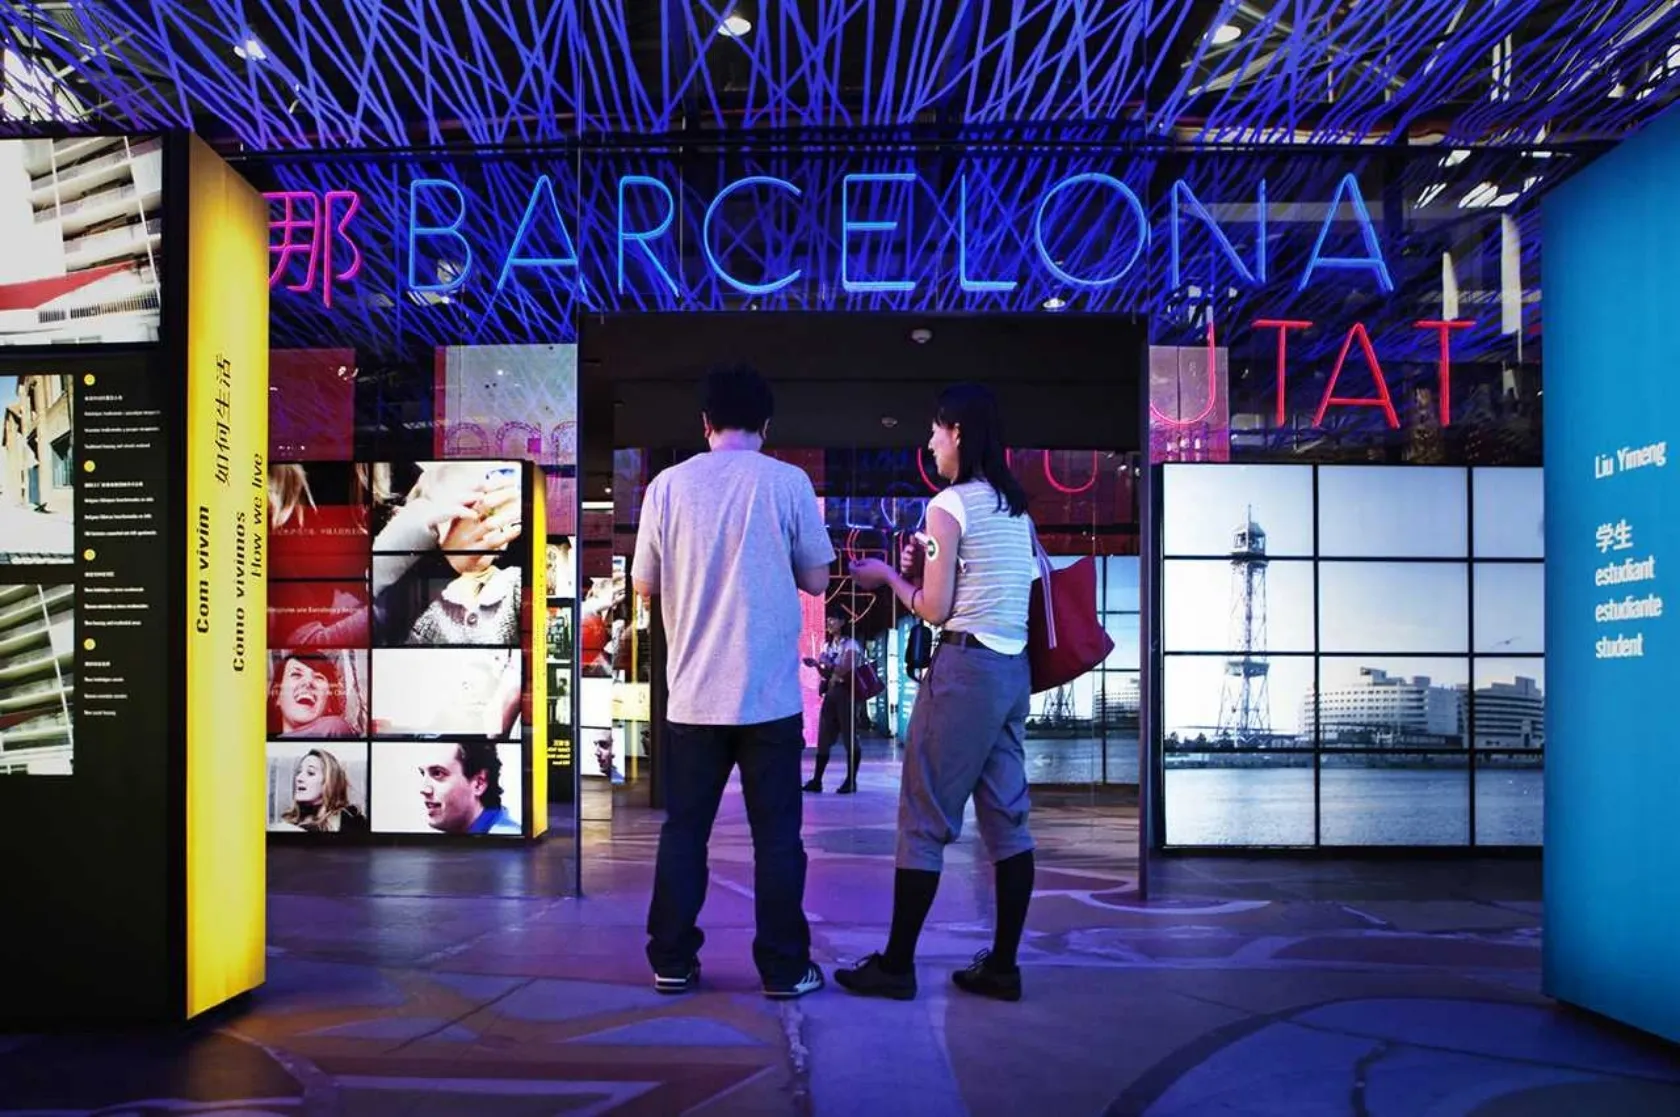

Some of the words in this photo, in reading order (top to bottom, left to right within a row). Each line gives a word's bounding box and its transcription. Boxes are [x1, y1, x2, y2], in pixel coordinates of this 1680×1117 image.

[408, 172, 1393, 294] BARCELONA
[214, 353, 231, 487] 如何生活
[251, 453, 263, 488] live
[1595, 453, 1614, 479] Liu
[1617, 441, 1666, 471] Yimeng
[252, 496, 263, 525] we
[196, 506, 210, 571] vivim
[233, 511, 246, 598] vivimos
[250, 533, 263, 578] How
[1595, 519, 1634, 554] 学生
[1595, 555, 1656, 586] estudiant
[196, 580, 210, 634] Com
[1595, 593, 1663, 623] estudiante
[232, 607, 246, 672] Cómo
[1595, 633, 1643, 658] student
